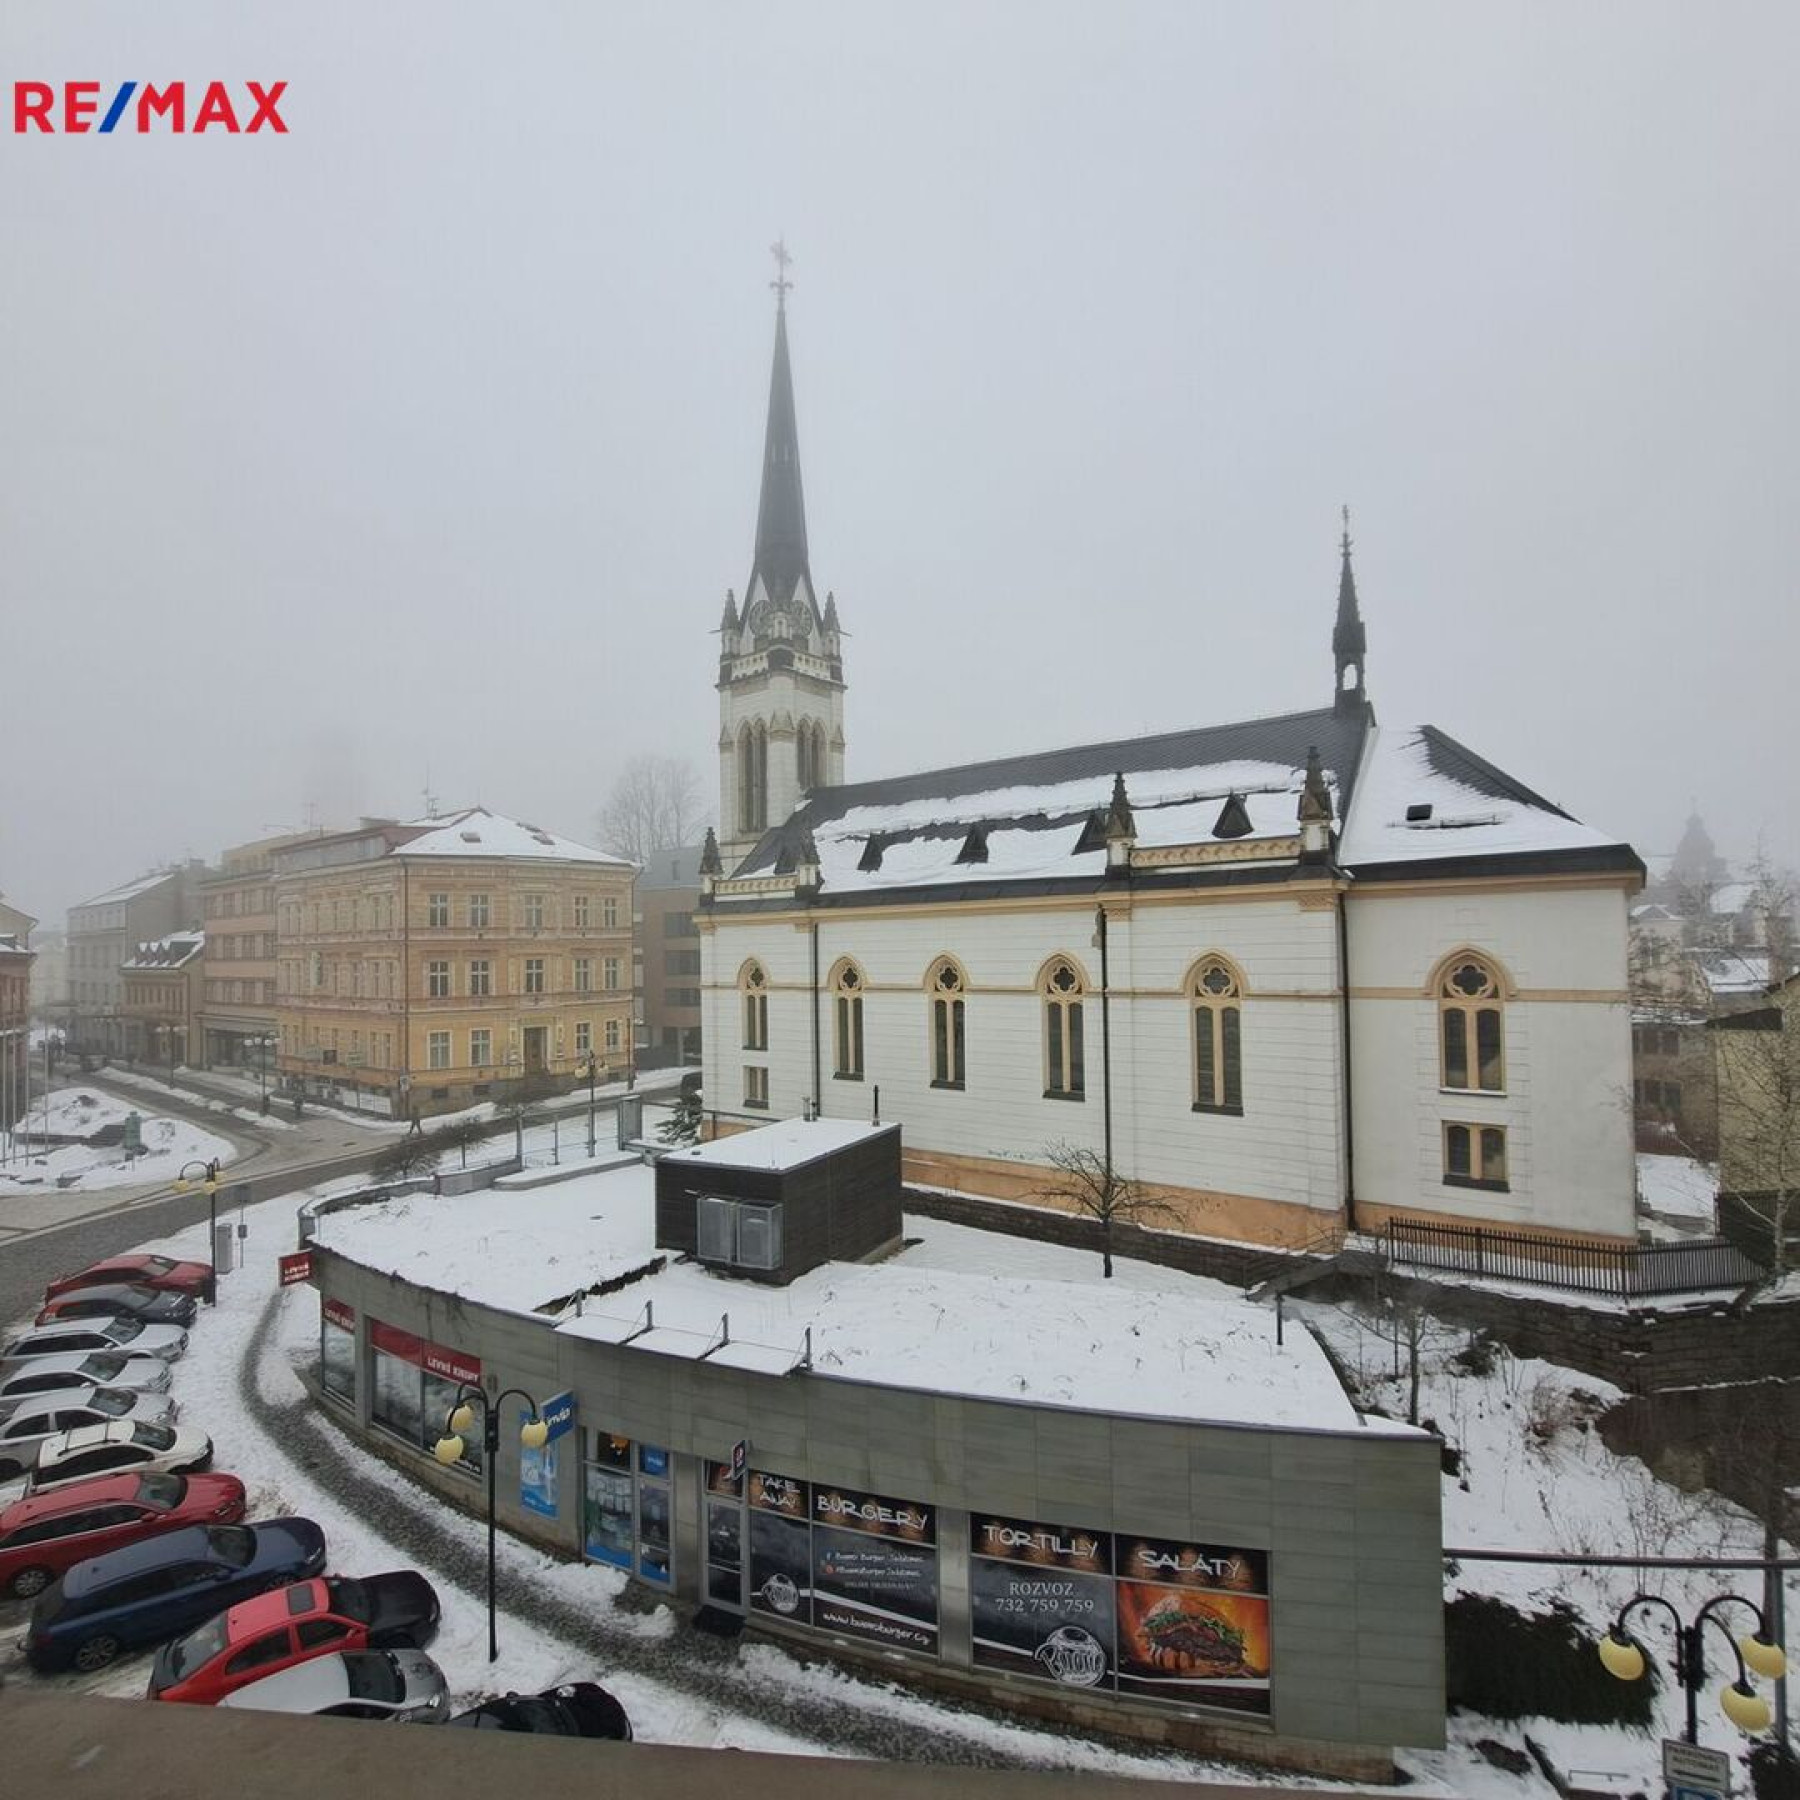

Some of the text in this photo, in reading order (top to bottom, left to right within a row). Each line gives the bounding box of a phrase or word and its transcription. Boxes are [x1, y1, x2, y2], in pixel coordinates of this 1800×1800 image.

[759, 1474, 801, 1493] TAKE
[817, 1495, 928, 1530] BURGERY
[982, 1524, 1098, 1558] TORTILLY
[1137, 1550, 1241, 1578] SALÁTY
[1009, 1582, 1074, 1596] ROZVOZ
[996, 1598, 1095, 1613] 732 759 759
